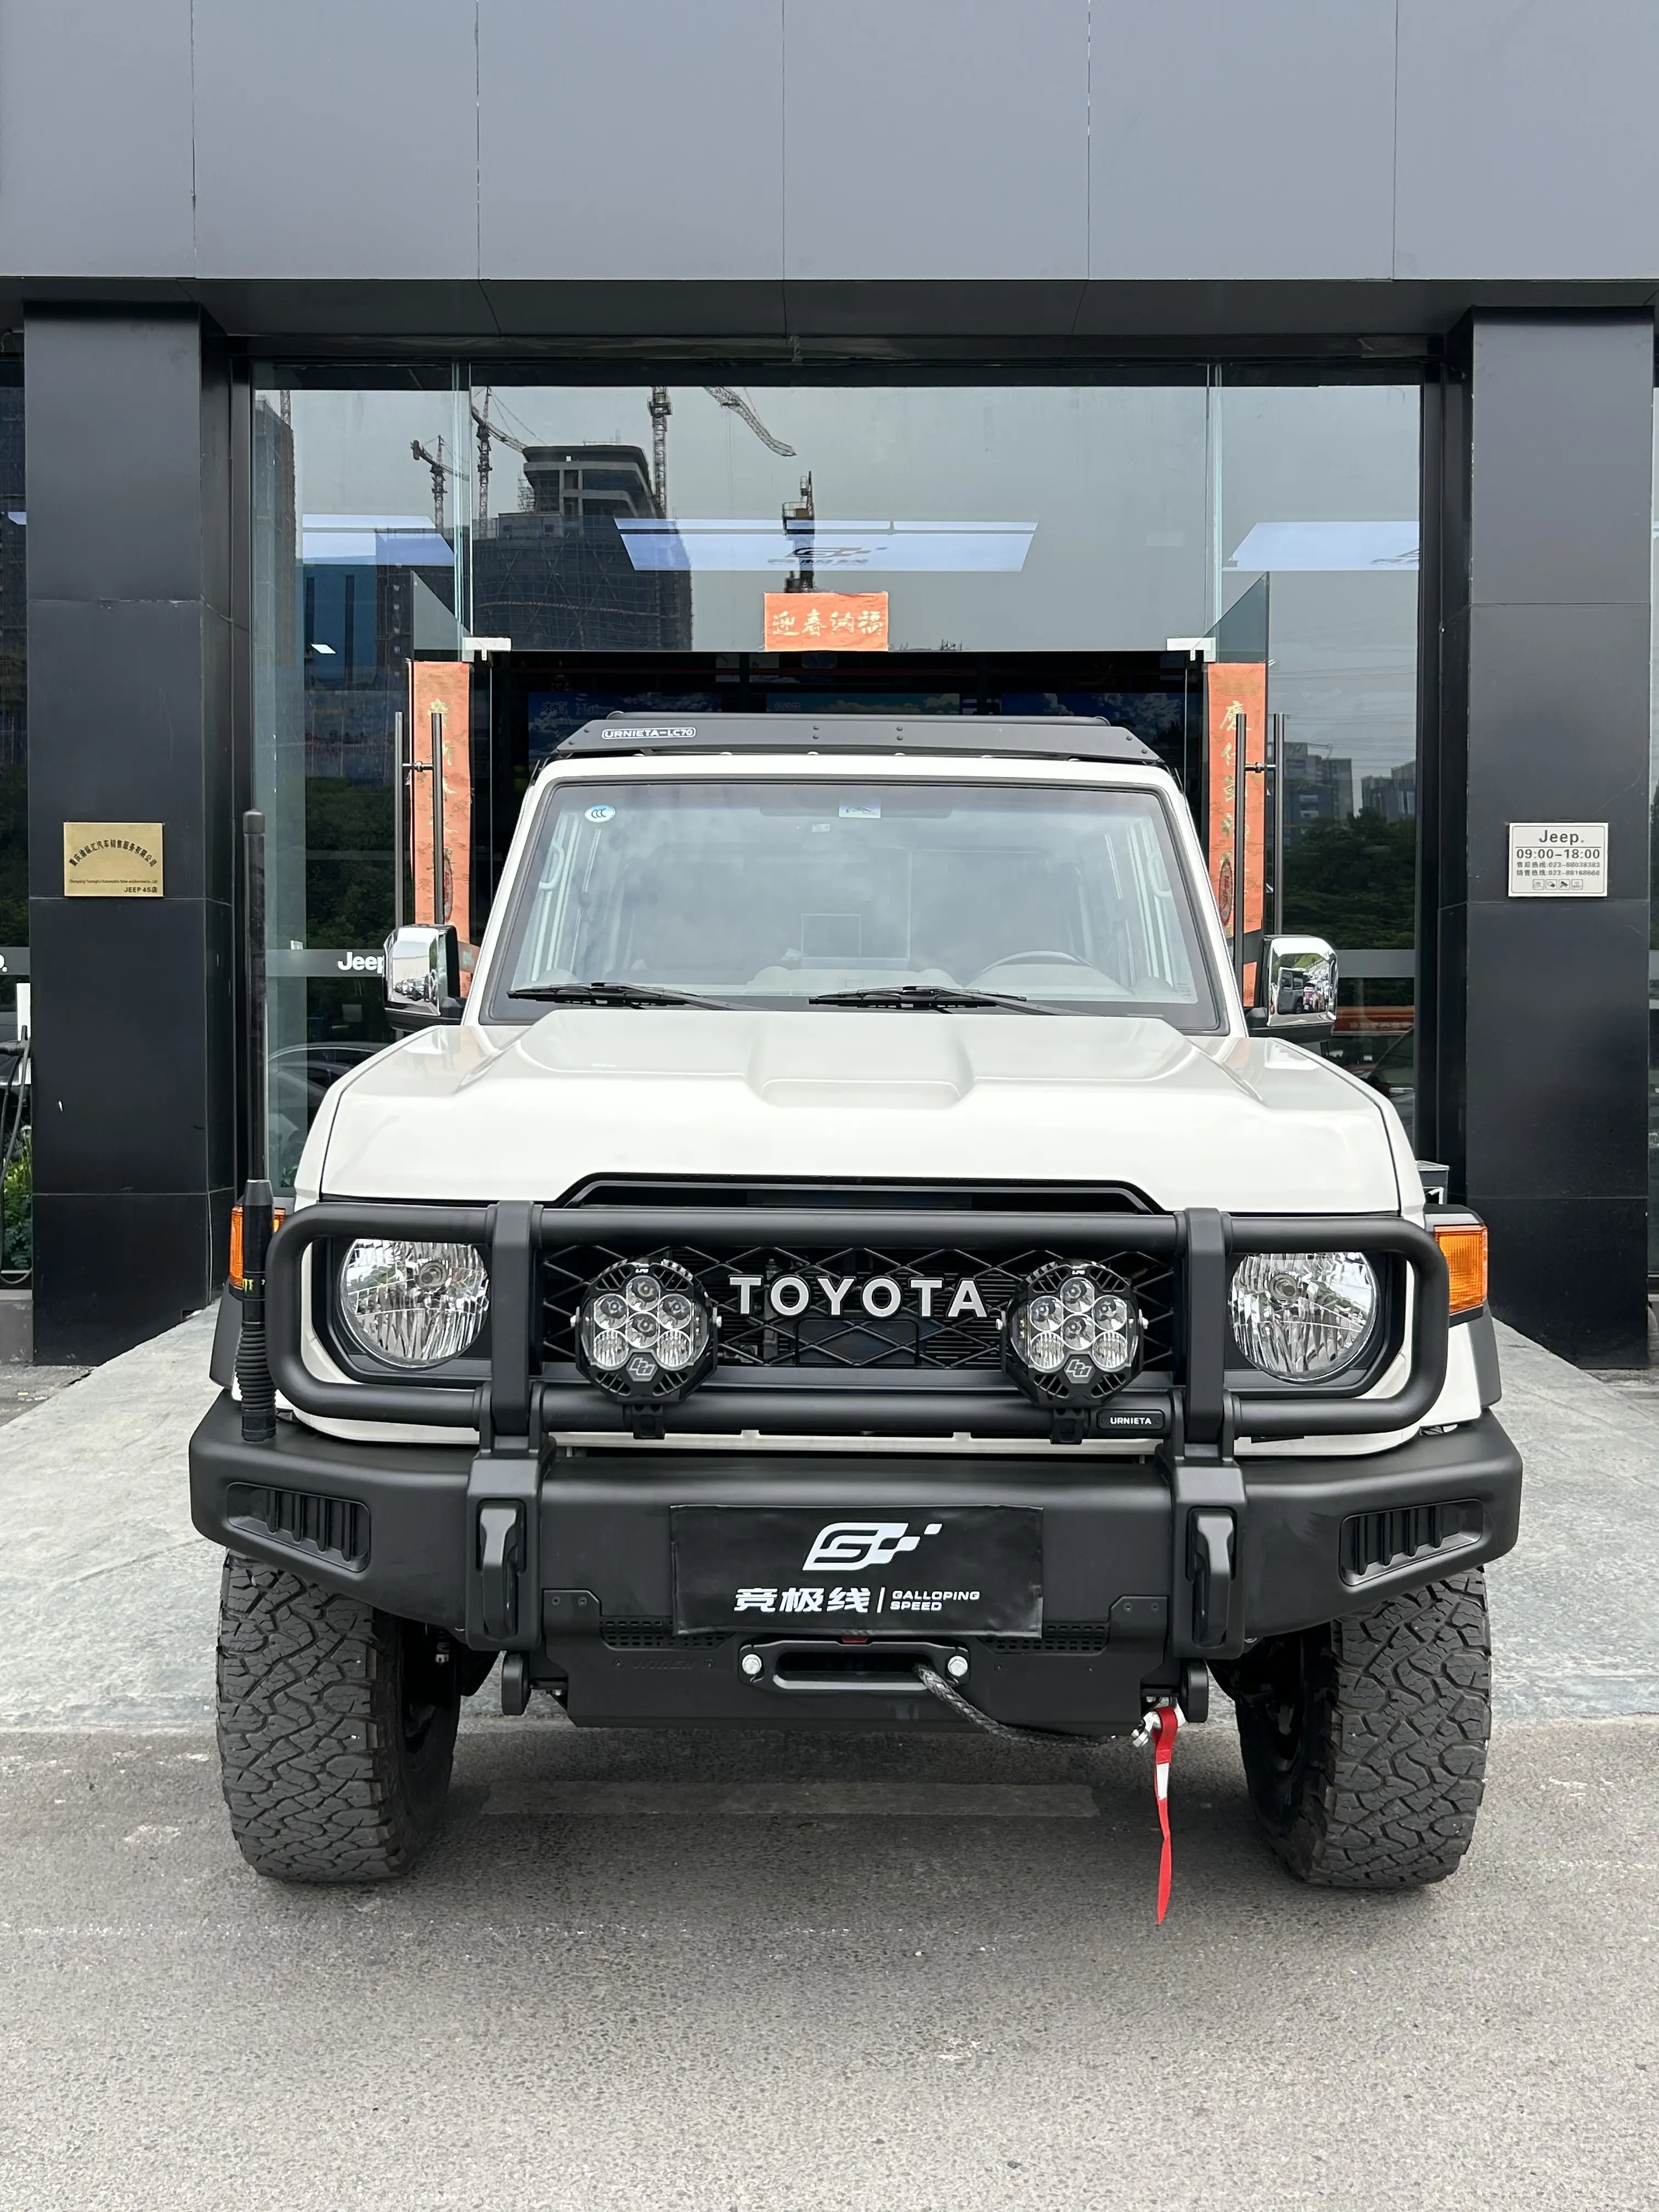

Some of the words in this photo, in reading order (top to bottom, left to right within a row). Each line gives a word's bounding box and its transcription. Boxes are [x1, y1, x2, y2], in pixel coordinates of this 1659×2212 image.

[605, 729, 693, 738] URNIETA-LC70
[1539, 830, 1584, 845] Jeep.
[729, 1277, 987, 1317] TOYOTA
[734, 1587, 871, 1612] 竞极线
[892, 1590, 980, 1600] GALLOPING
[890, 1601, 943, 1611] SPEED
